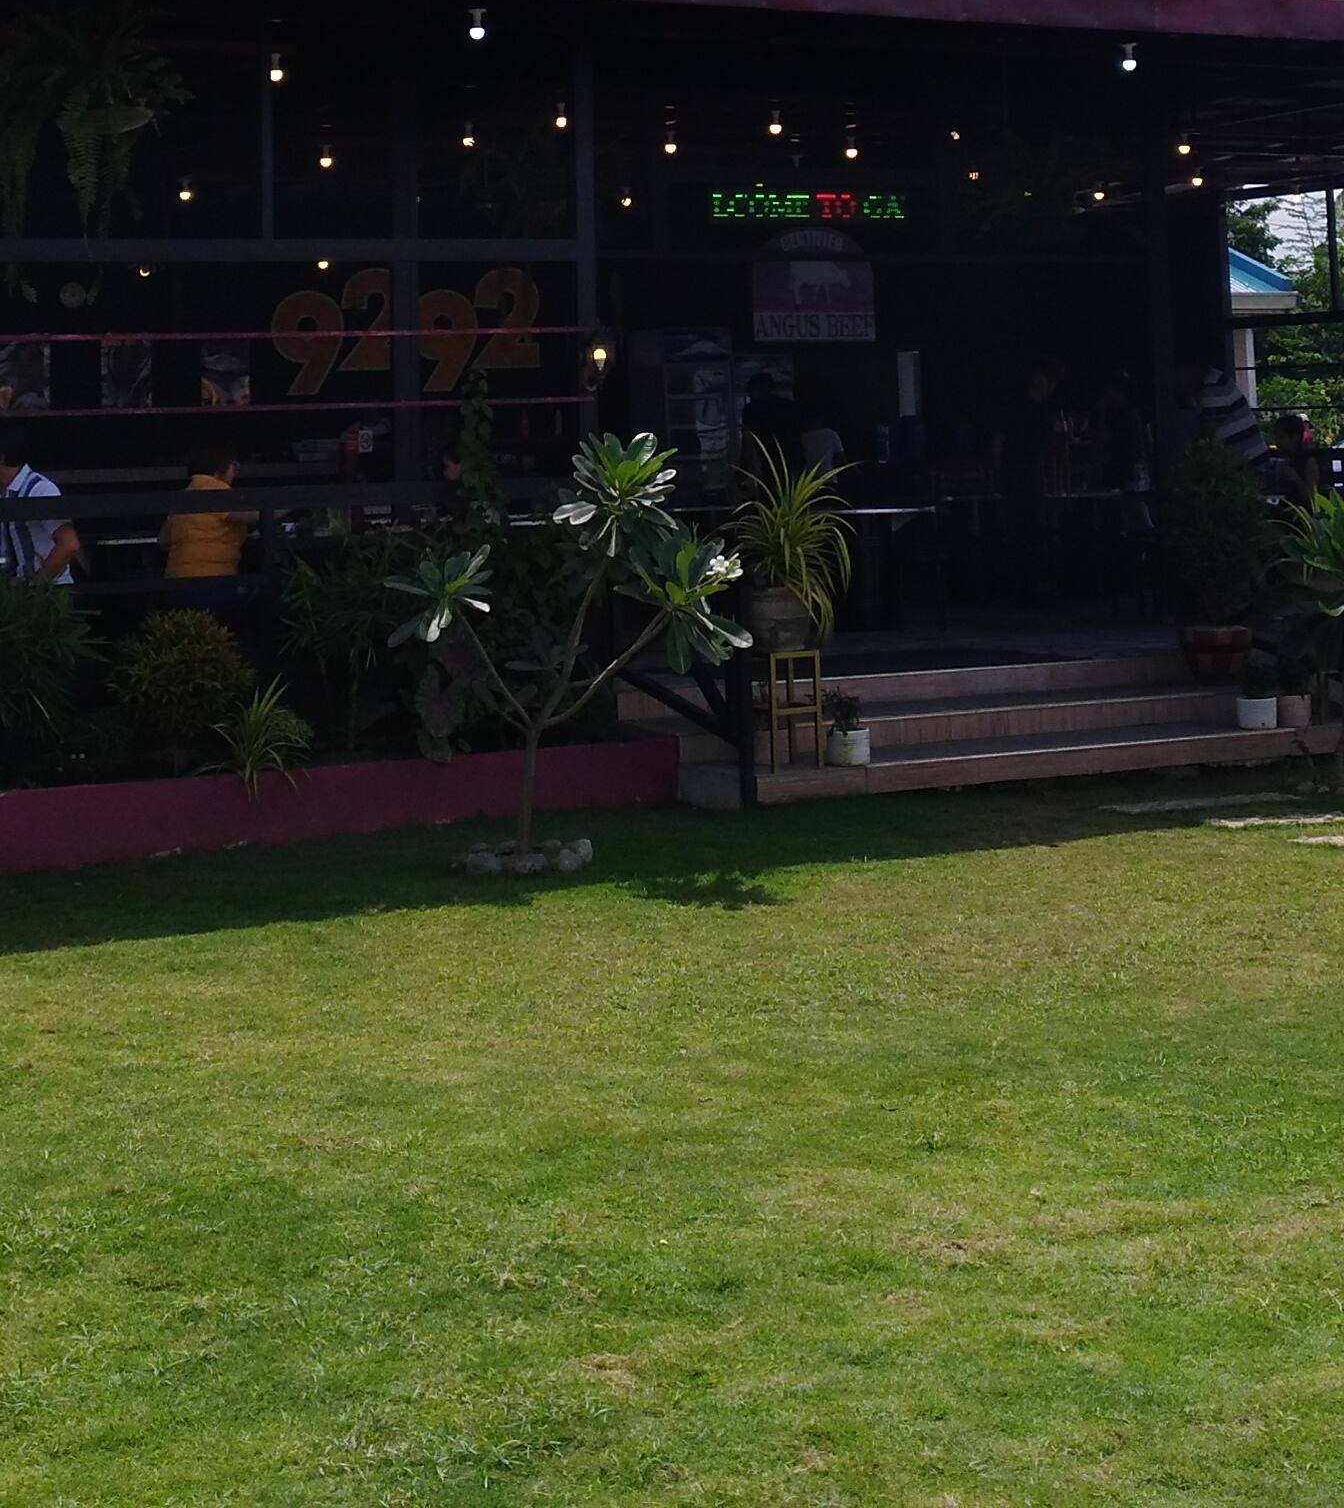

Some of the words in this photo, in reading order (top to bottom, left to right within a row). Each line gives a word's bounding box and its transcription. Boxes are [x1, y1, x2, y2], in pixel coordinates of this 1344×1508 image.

[270, 267, 541, 396] 9292
[755, 313, 820, 339] ANGUS
[827, 313, 875, 339] BEEF
